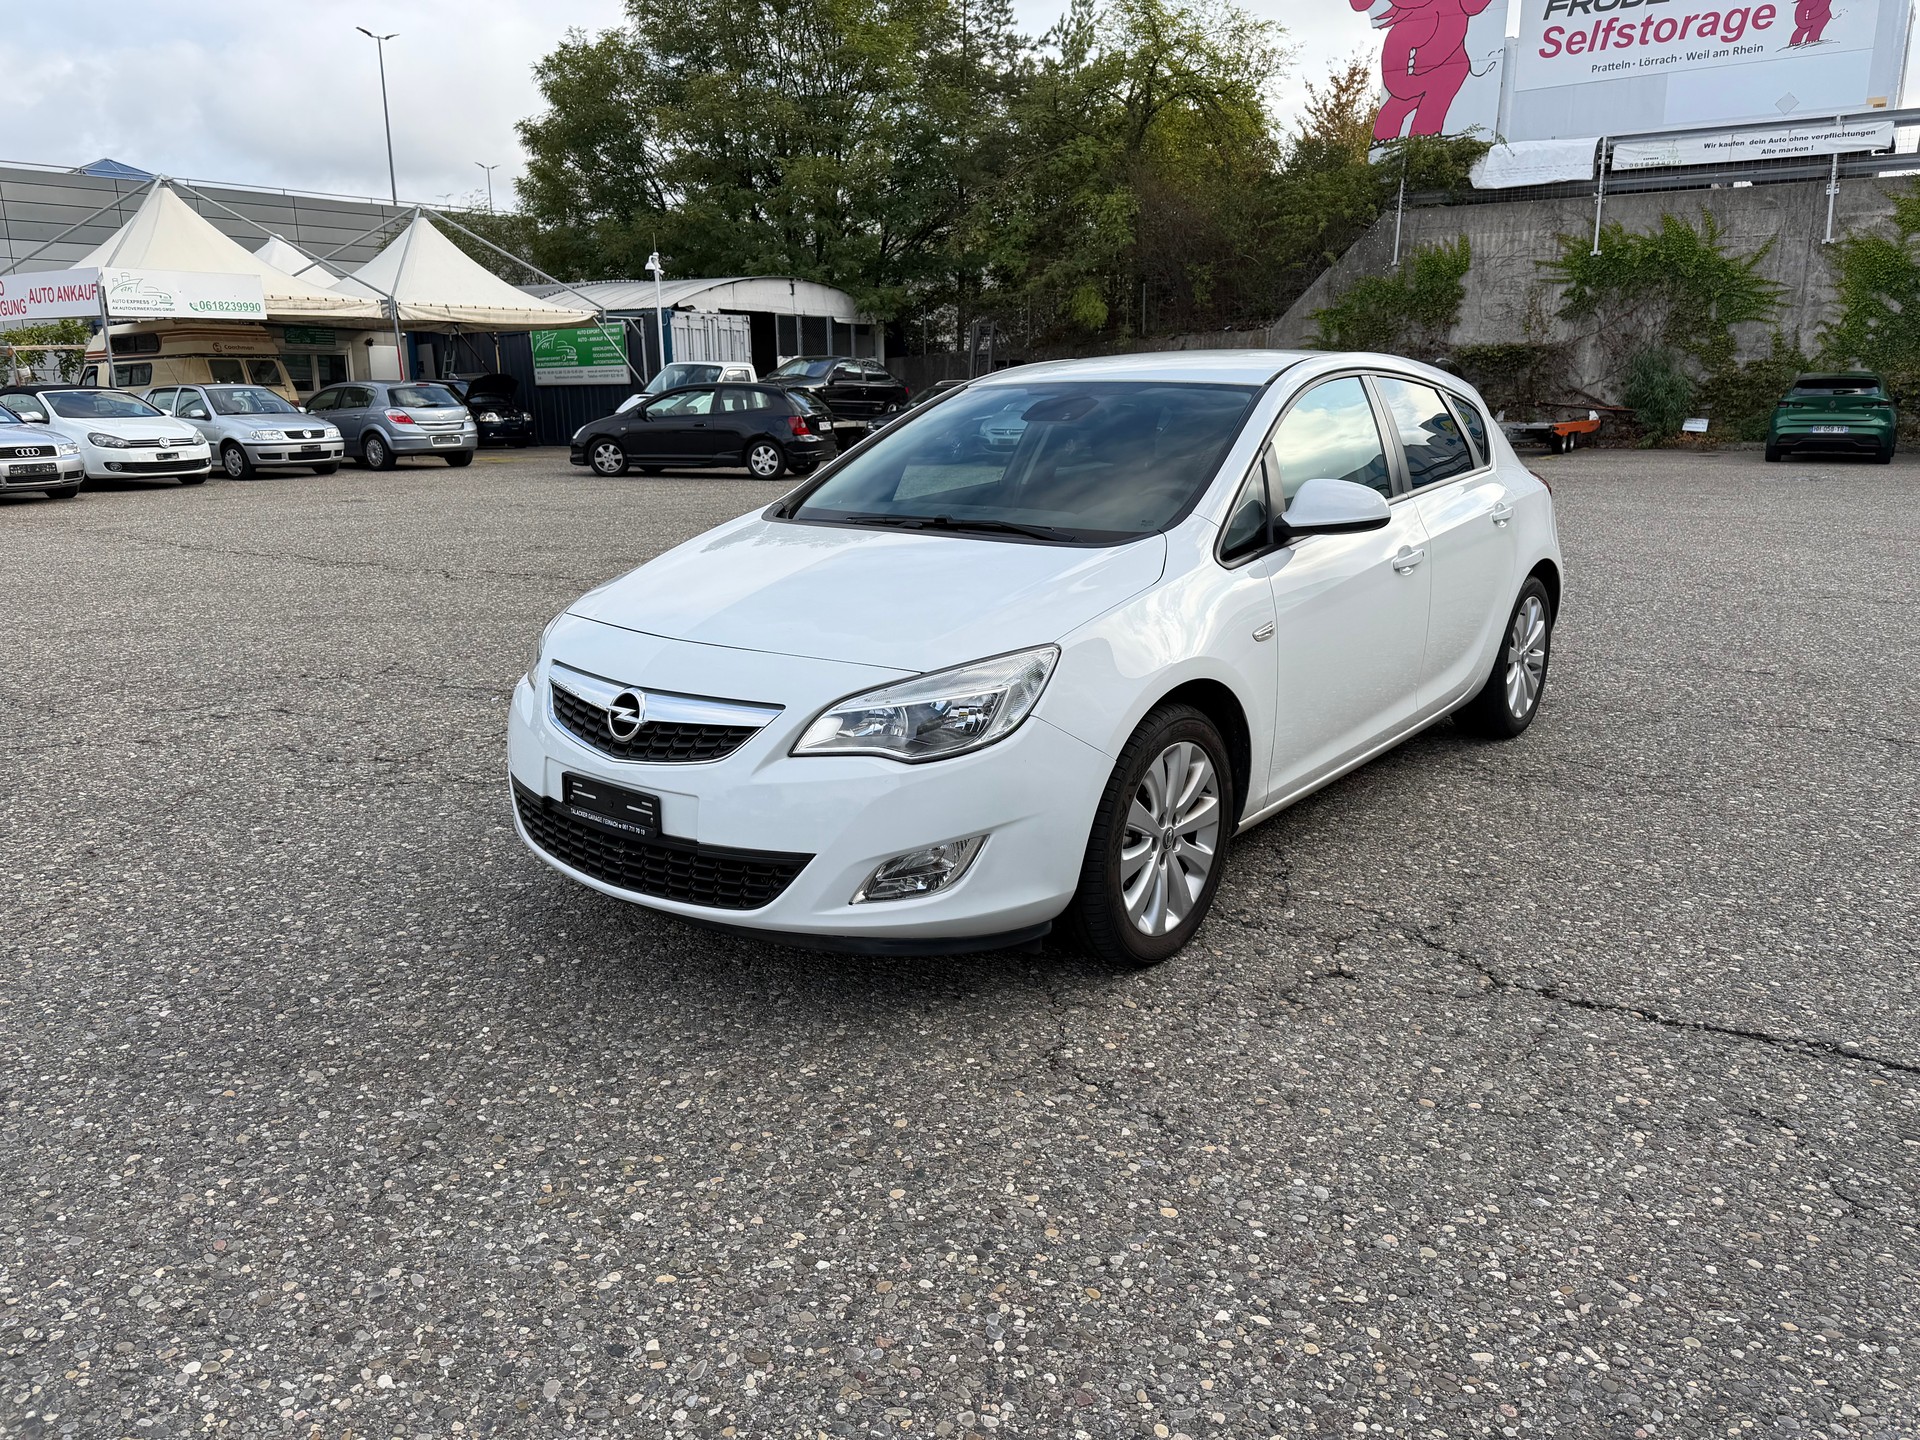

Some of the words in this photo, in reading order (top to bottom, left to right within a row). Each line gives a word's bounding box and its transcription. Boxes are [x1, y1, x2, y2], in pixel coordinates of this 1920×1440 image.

[1538, 3, 1777, 58] Selfstorage
[1591, 62, 1631, 73] Pratteln
[1639, 56, 1677, 67] Lörrach
[1686, 50, 1710, 61] Weil
[1712, 50, 1729, 59] am
[1732, 44, 1764, 55] Rhein
[1718, 140, 1745, 148] kaufen
[1811, 129, 1876, 141] verpflichtungen
[1778, 146, 1809, 154] marken
[29, 287, 55, 304] AUTO
[57, 284, 97, 302] ANKAUF
[200, 300, 261, 312] 0618239990
